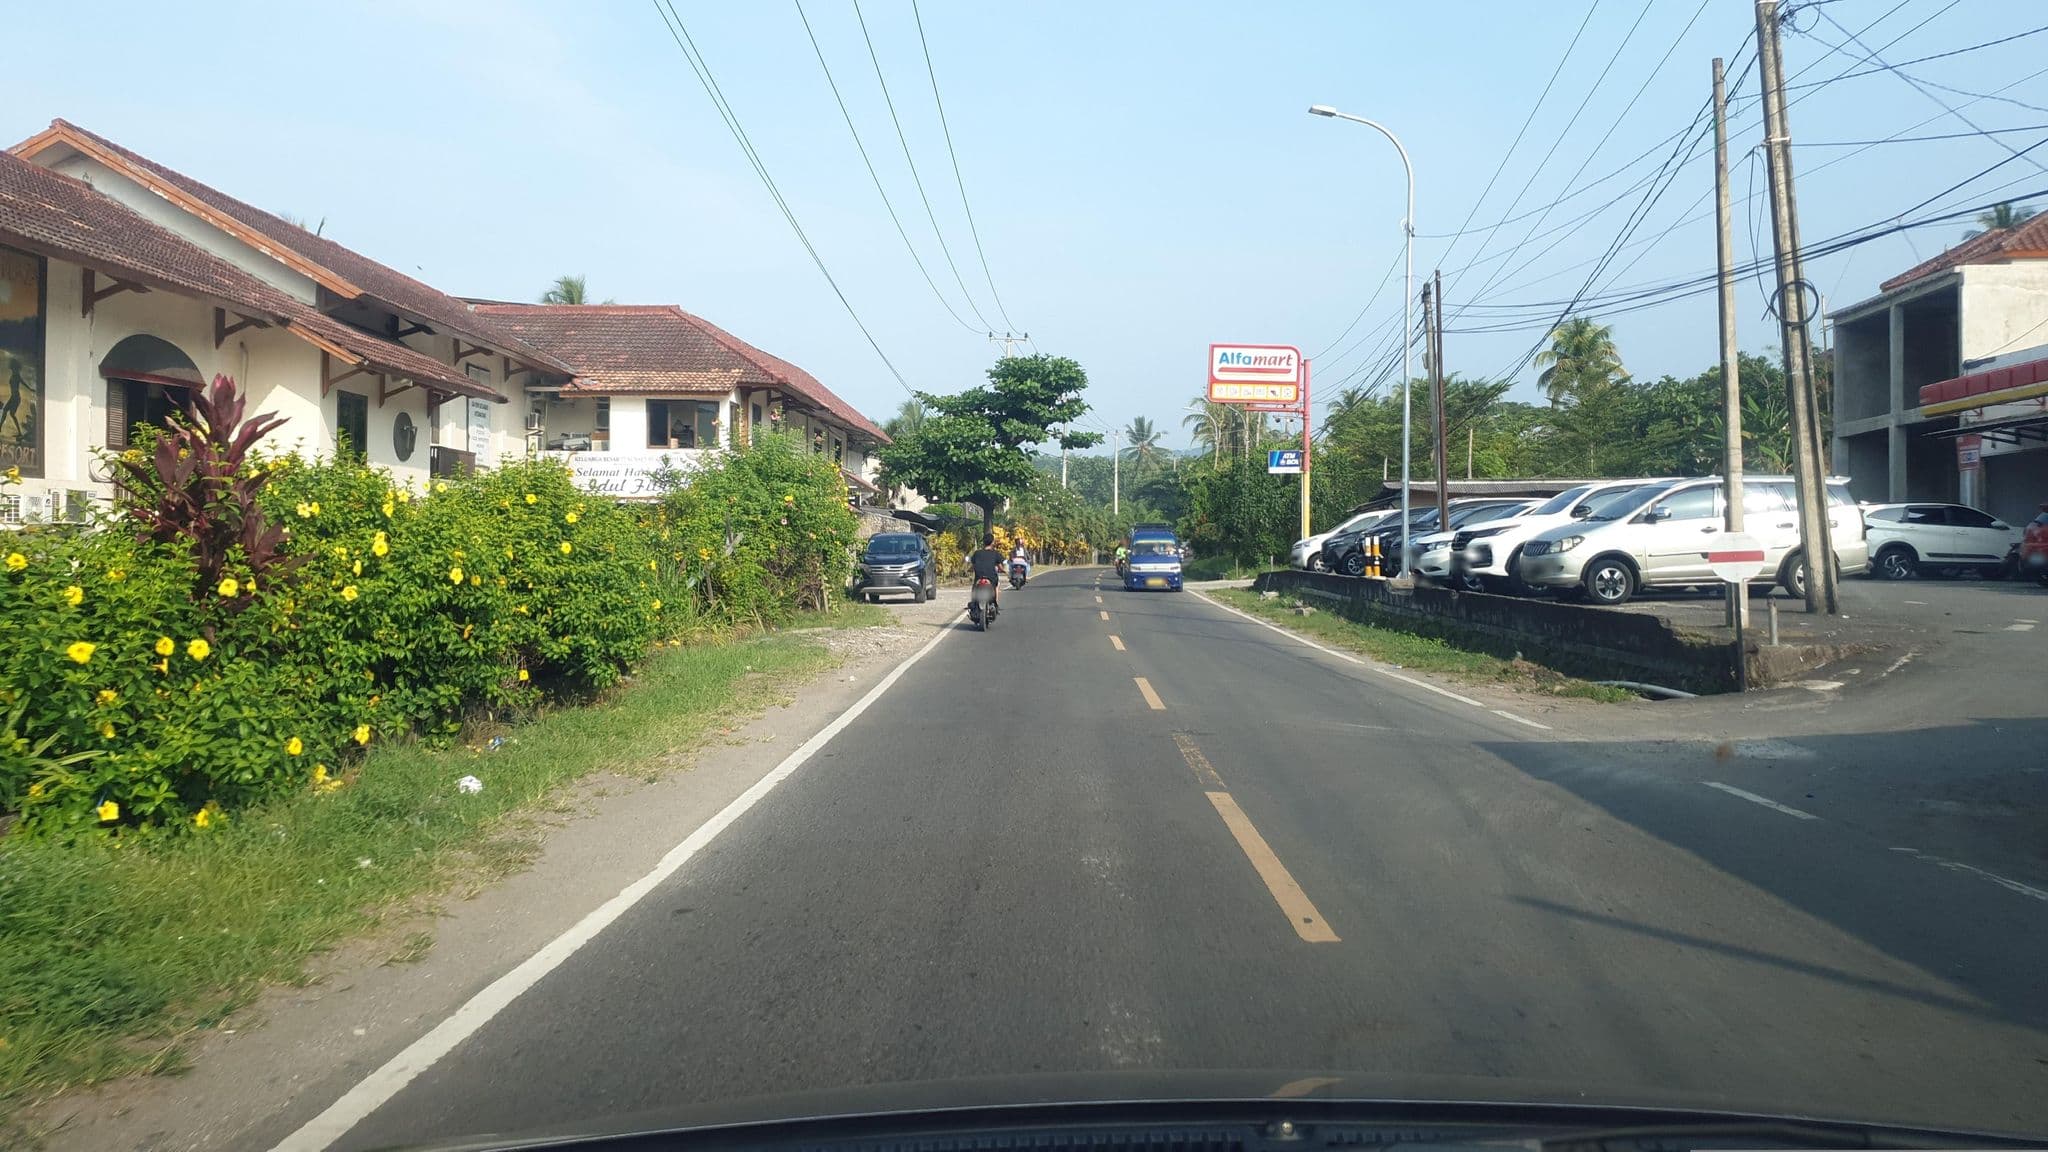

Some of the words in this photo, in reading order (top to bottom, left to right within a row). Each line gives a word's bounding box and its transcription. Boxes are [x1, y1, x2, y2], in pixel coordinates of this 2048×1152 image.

[1218, 351, 1293, 366] Alfamart
[0, 442, 36, 465] ESORT
[576, 467, 620, 477] Selamat
[584, 478, 628, 493] Idul
